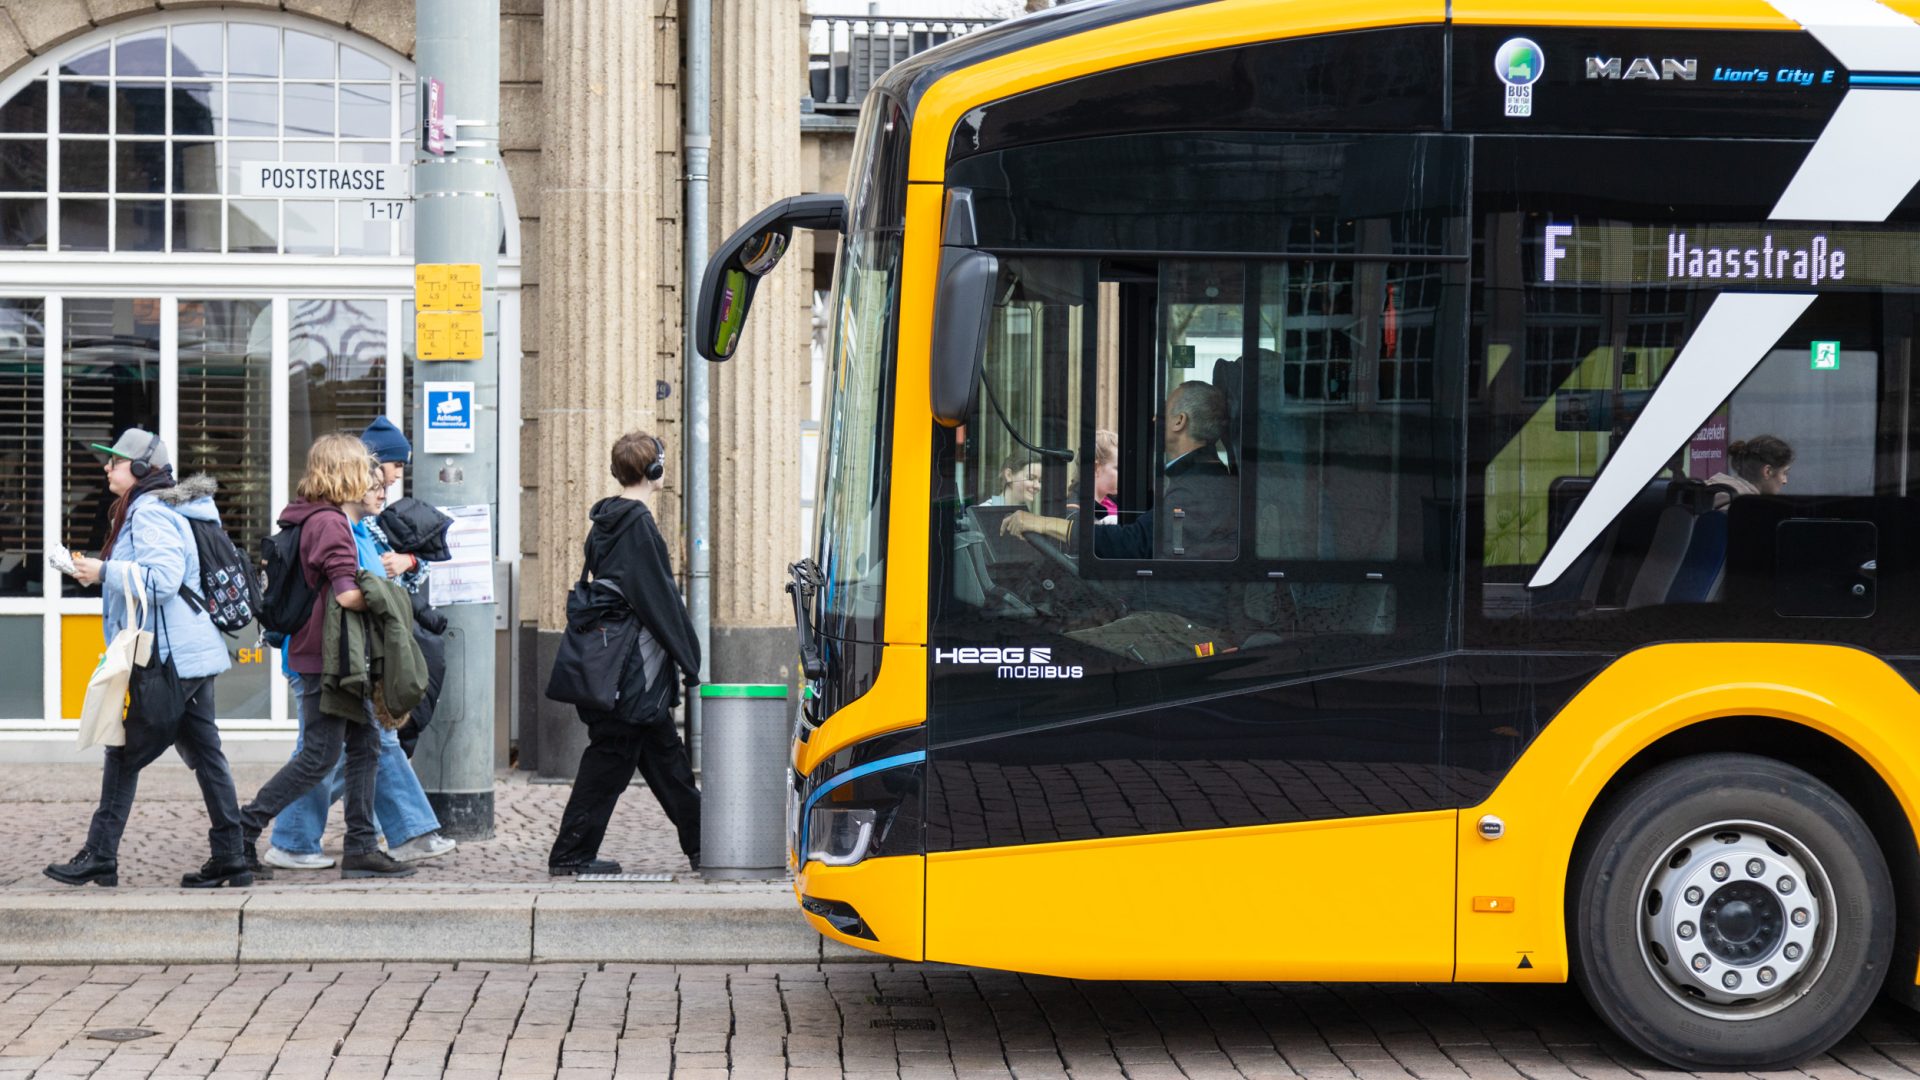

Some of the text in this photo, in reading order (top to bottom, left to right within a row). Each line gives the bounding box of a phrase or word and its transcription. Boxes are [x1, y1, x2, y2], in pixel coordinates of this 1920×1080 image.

[1586, 57, 1697, 80] MAN
[1712, 67, 1836, 86] Lion's City E
[1508, 85, 1530, 97] BUS
[1508, 104, 1530, 114] 2023
[261, 168, 385, 190] POSTSTRASSE
[369, 202, 404, 220] 1-17
[1544, 225, 1572, 281] F
[1667, 233, 1846, 286] Haasstraße
